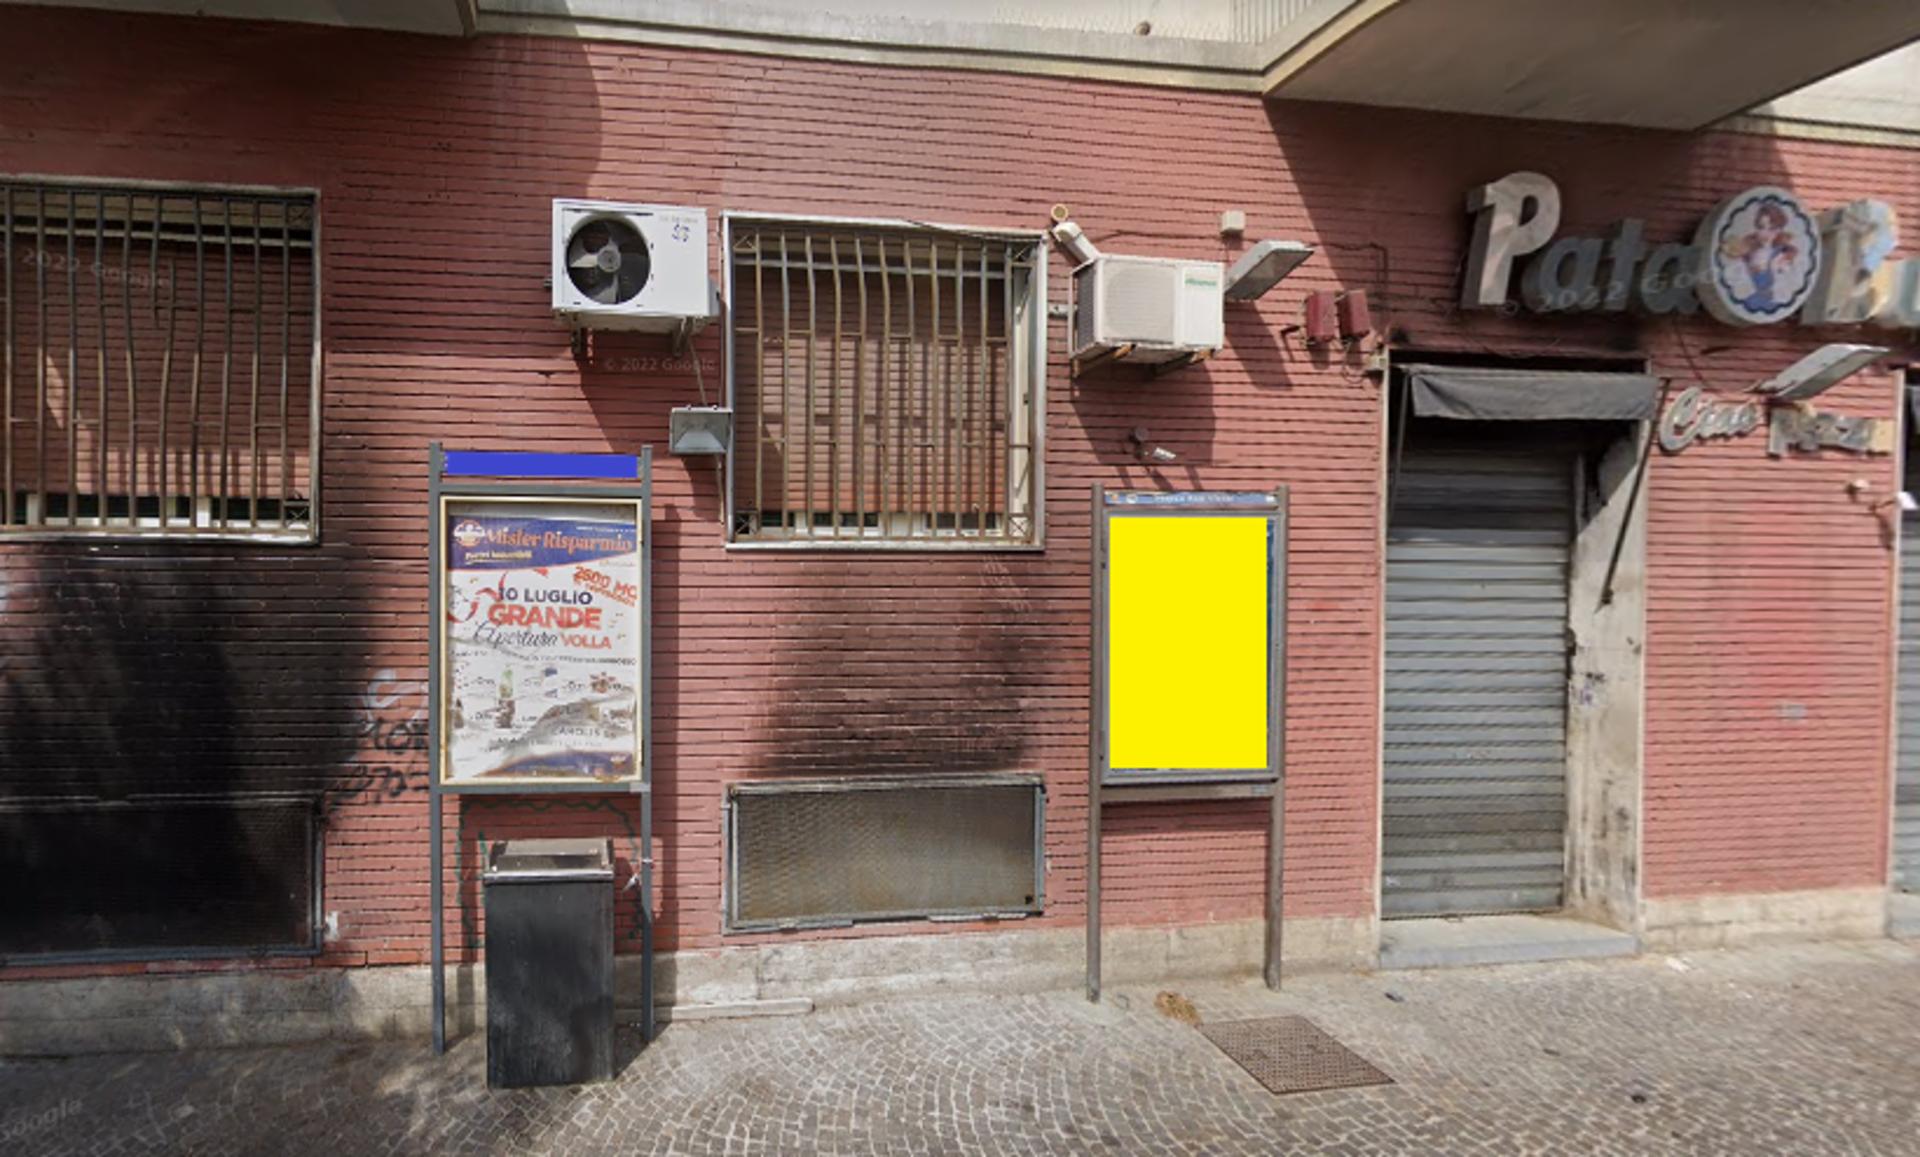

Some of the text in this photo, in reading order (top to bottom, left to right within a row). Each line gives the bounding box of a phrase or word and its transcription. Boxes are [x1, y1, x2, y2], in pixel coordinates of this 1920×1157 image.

[1461, 171, 1700, 314] Pata
[524, 587, 593, 605] LUGLIO
[487, 603, 603, 630] GRANDE
[560, 632, 612, 650] VOLLA
